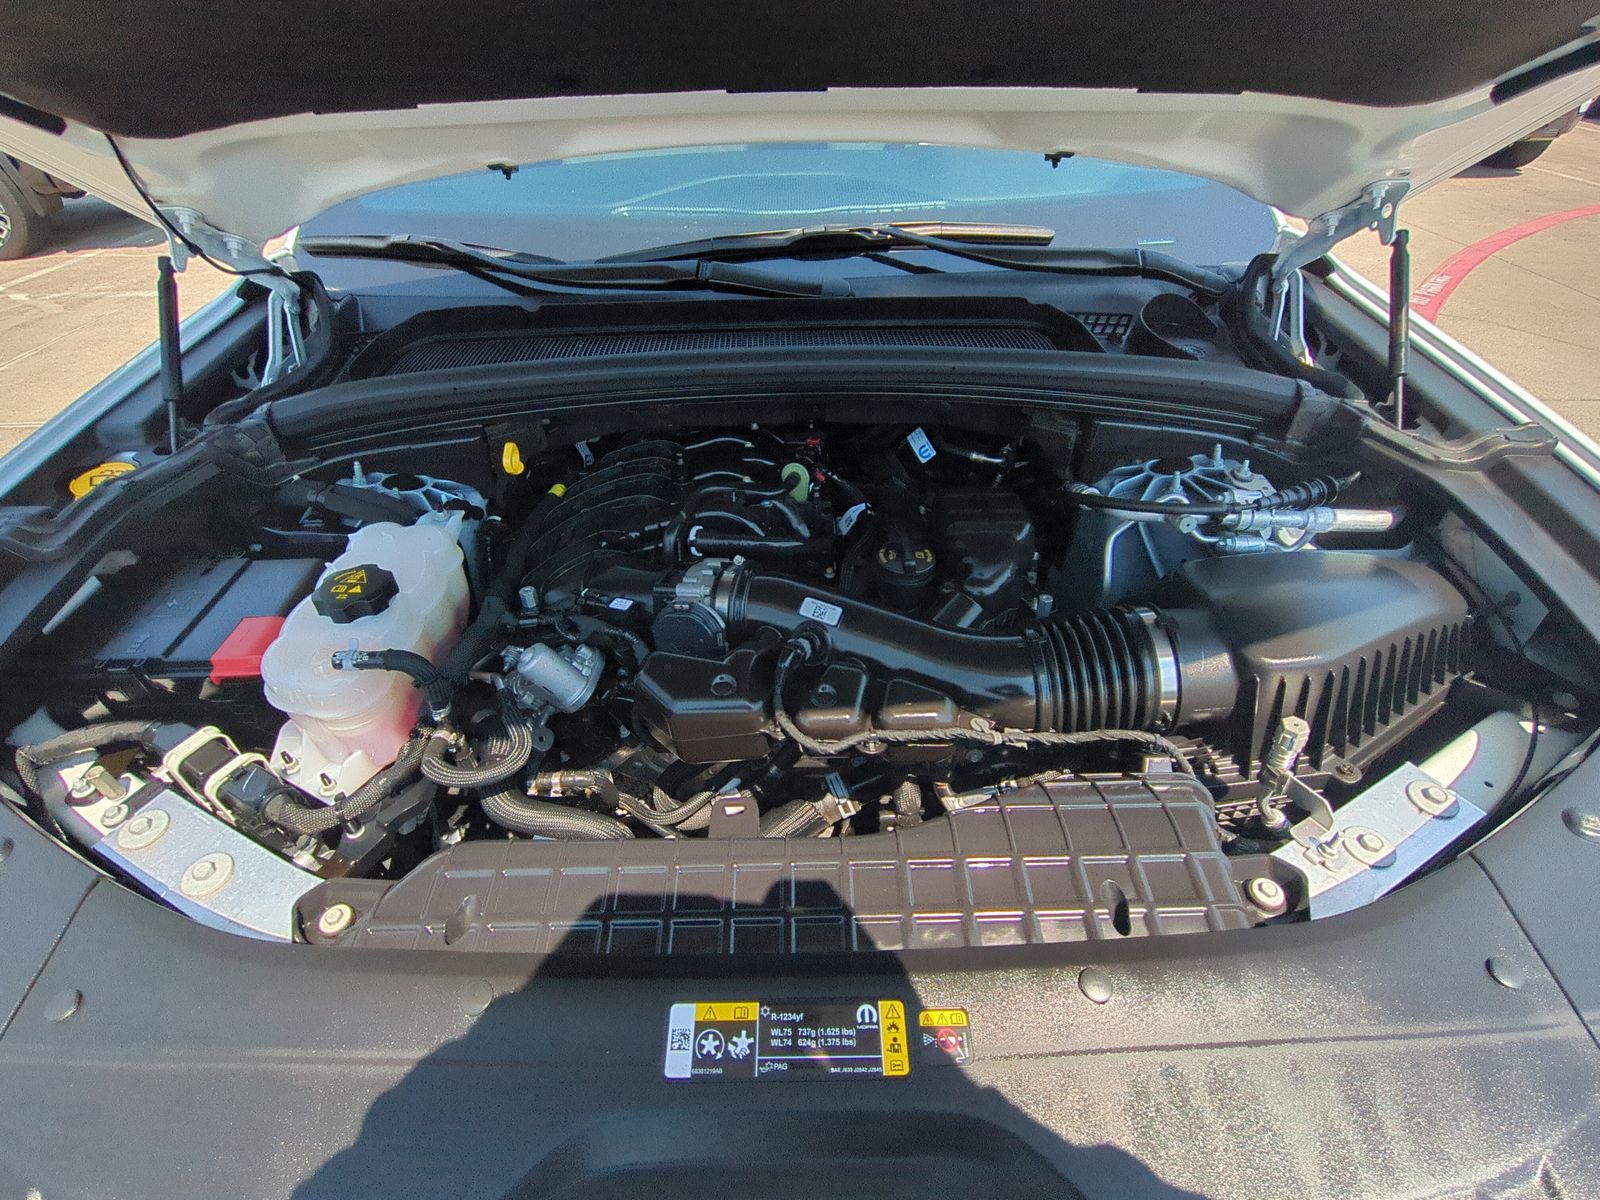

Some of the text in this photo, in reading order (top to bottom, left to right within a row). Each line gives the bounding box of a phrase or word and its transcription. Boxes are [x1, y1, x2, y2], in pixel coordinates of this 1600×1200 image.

[771, 1012, 804, 1022] R-1234yf
[770, 1027, 856, 1038] WL75 737g (1.625 lbs)
[770, 1038, 857, 1048] WL74 624g (1.375 lbs)
[773, 1062, 788, 1071] PAG
